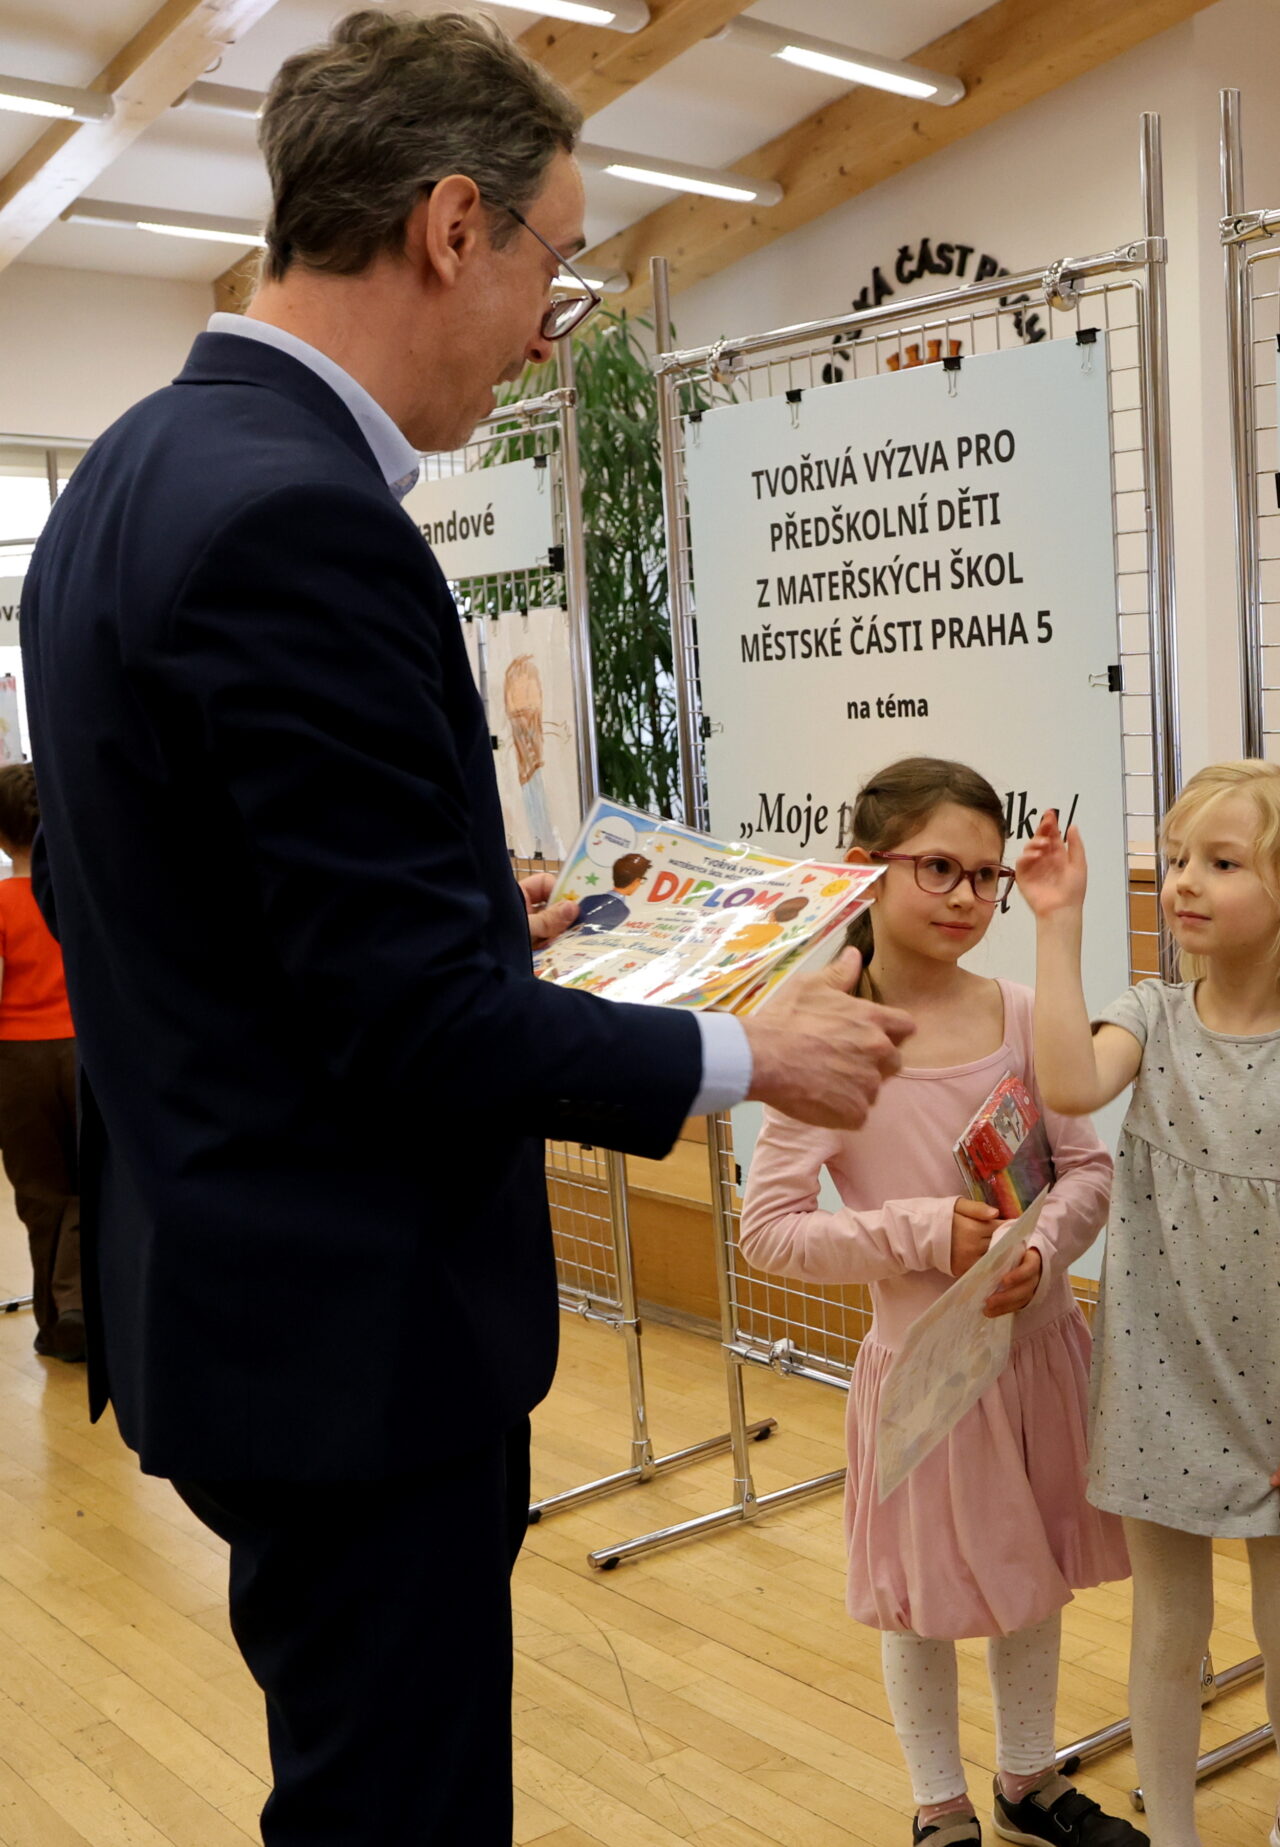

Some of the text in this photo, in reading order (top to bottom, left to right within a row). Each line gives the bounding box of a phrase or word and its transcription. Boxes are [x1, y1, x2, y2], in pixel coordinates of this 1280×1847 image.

[752, 429, 1015, 499] TVOŘIVÁ VÝZVA PRO
[770, 488, 1001, 552] PŘEDŠKOLNÍ DĚTI
[756, 549, 1024, 608] Z MATEŘSKÝCH ŠKOL
[740, 610, 1053, 663] MĚSTSKÉ ČÁSTI PRAHA 5
[847, 694, 929, 720] na téma
[740, 793, 828, 848] „Moje
[647, 870, 784, 909] DIPLOM
